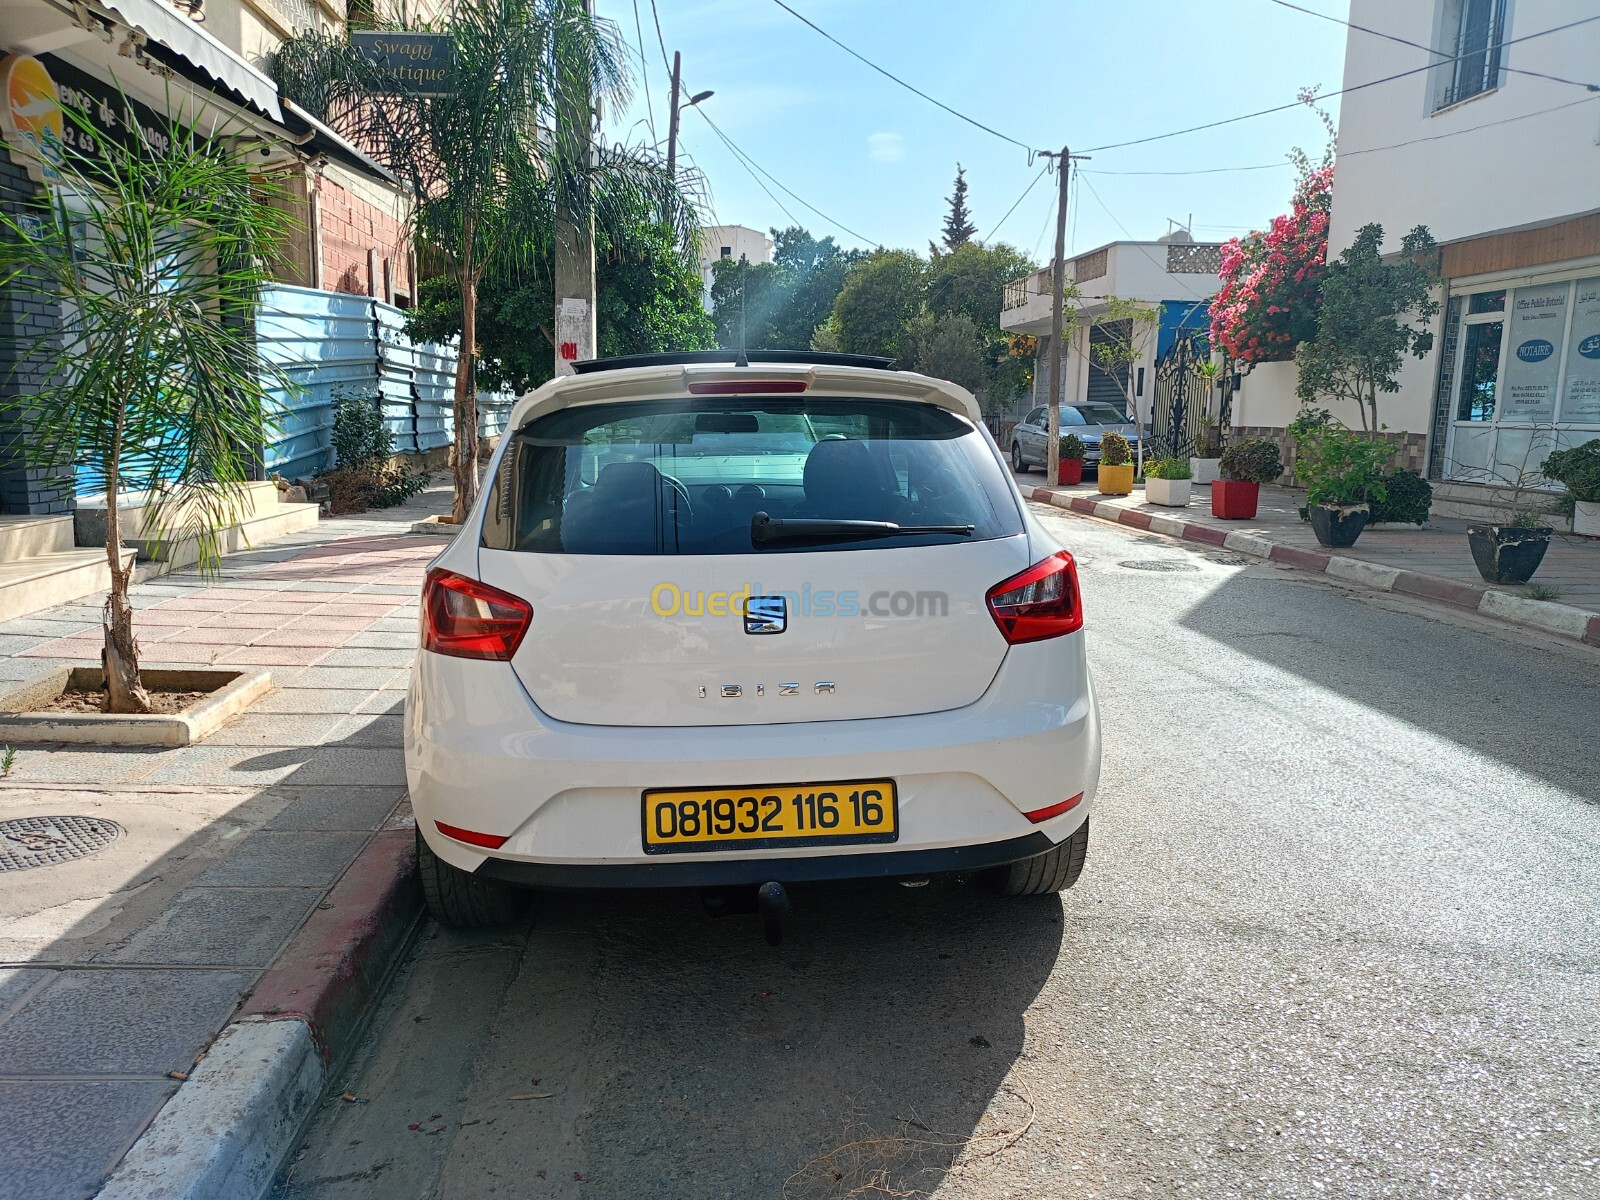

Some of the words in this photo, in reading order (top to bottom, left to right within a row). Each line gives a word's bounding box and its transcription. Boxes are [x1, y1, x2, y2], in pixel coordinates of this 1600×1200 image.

[373, 39, 433, 61] Swagg
[365, 63, 446, 86] outique
[99, 97, 117, 128] de
[79, 132, 95, 153] 63
[1519, 344, 1551, 357] NOTAIRE
[698, 681, 836, 699] IBIZA
[655, 795, 783, 839] 081932
[792, 792, 840, 830] 116
[848, 789, 884, 827] 16
